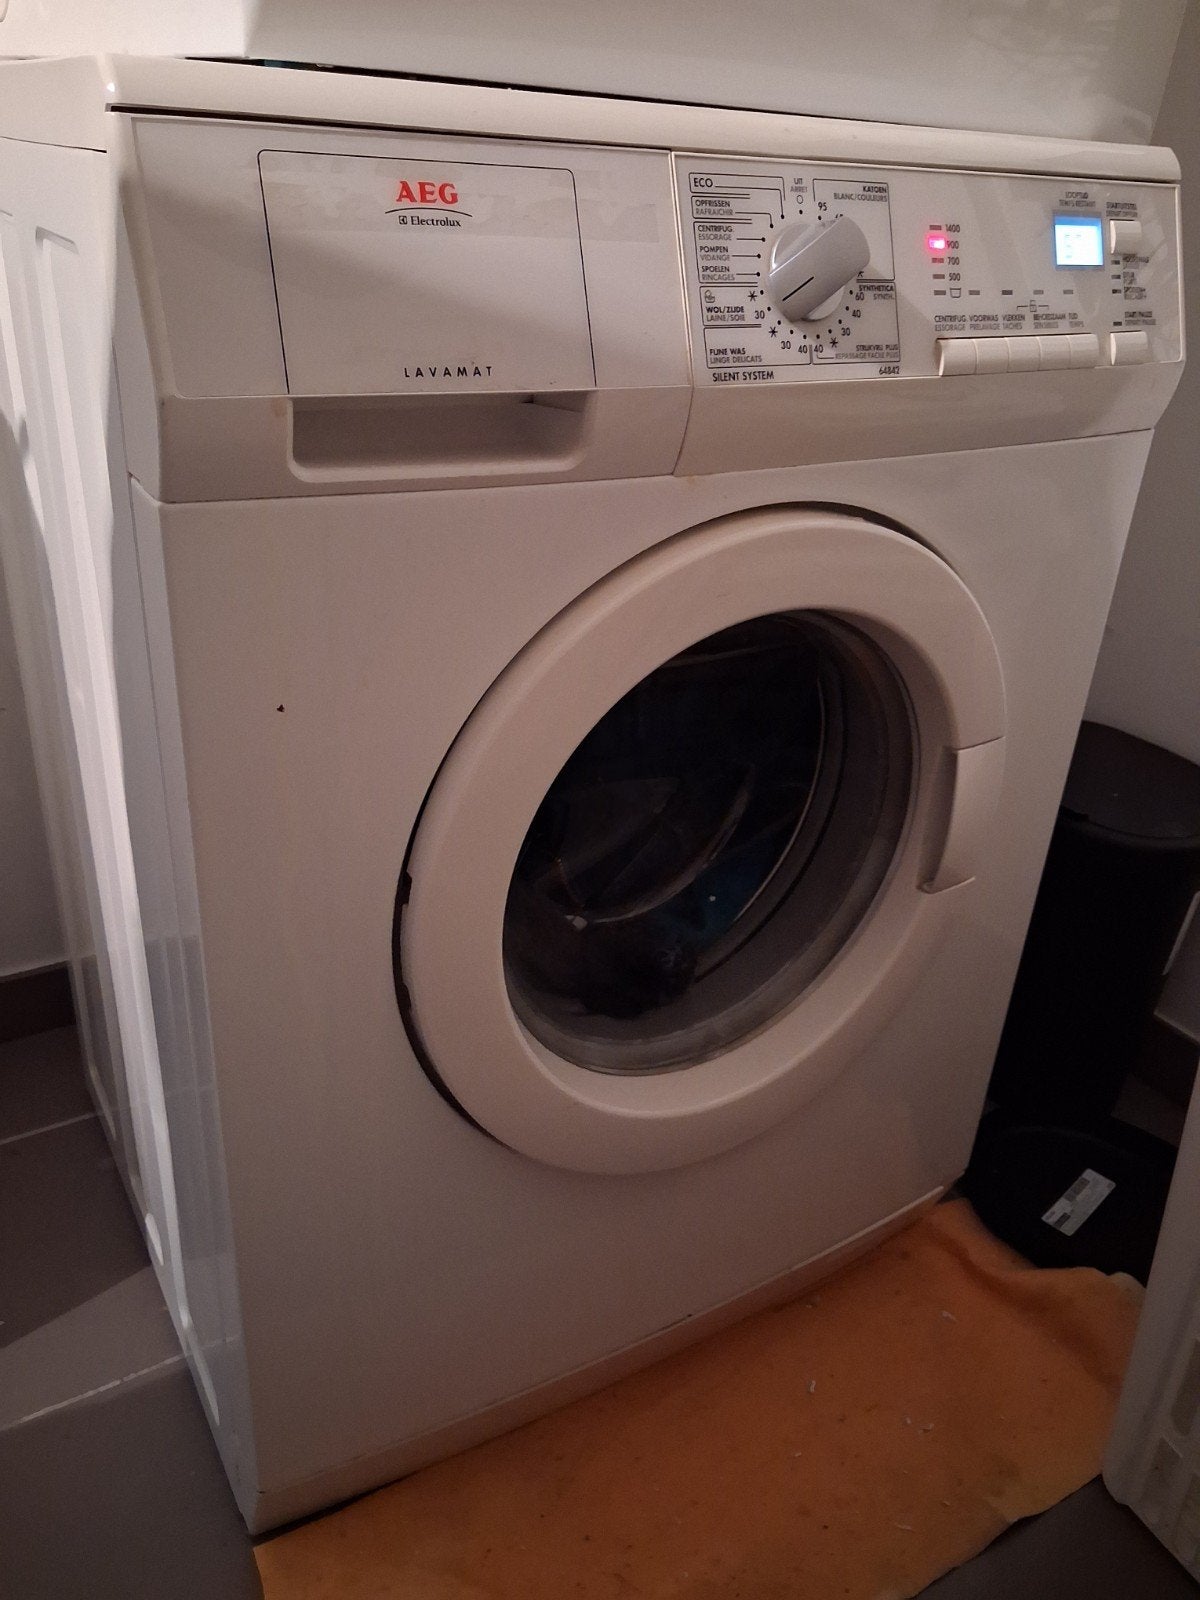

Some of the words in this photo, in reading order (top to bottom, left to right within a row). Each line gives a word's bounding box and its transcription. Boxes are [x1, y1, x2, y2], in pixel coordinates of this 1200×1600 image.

[693, 177, 713, 188] ECO
[396, 180, 459, 204] AEG
[863, 186, 887, 194] KATOEN
[695, 199, 731, 208] OPFRISSEN
[817, 201, 827, 212] 95
[410, 215, 461, 227] Electrolux
[945, 223, 961, 233] 1400
[698, 233, 732, 241] ESSORAGE
[700, 245, 729, 253] POMPEN
[946, 240, 960, 250] 900
[947, 256, 960, 266] 700
[701, 265, 730, 273] SPOELEN
[948, 272, 961, 282] 500
[855, 291, 865, 301] 60
[754, 310, 766, 320] 30
[851, 309, 862, 318] 40
[841, 327, 851, 337] 30
[780, 340, 792, 350] 30
[797, 345, 808, 354] 40
[813, 344, 824, 354] 40
[729, 347, 746, 355] WAS
[404, 366, 492, 378] LAVAMAT
[712, 372, 740, 383] SILENT
[742, 370, 775, 380] SYSTEM
